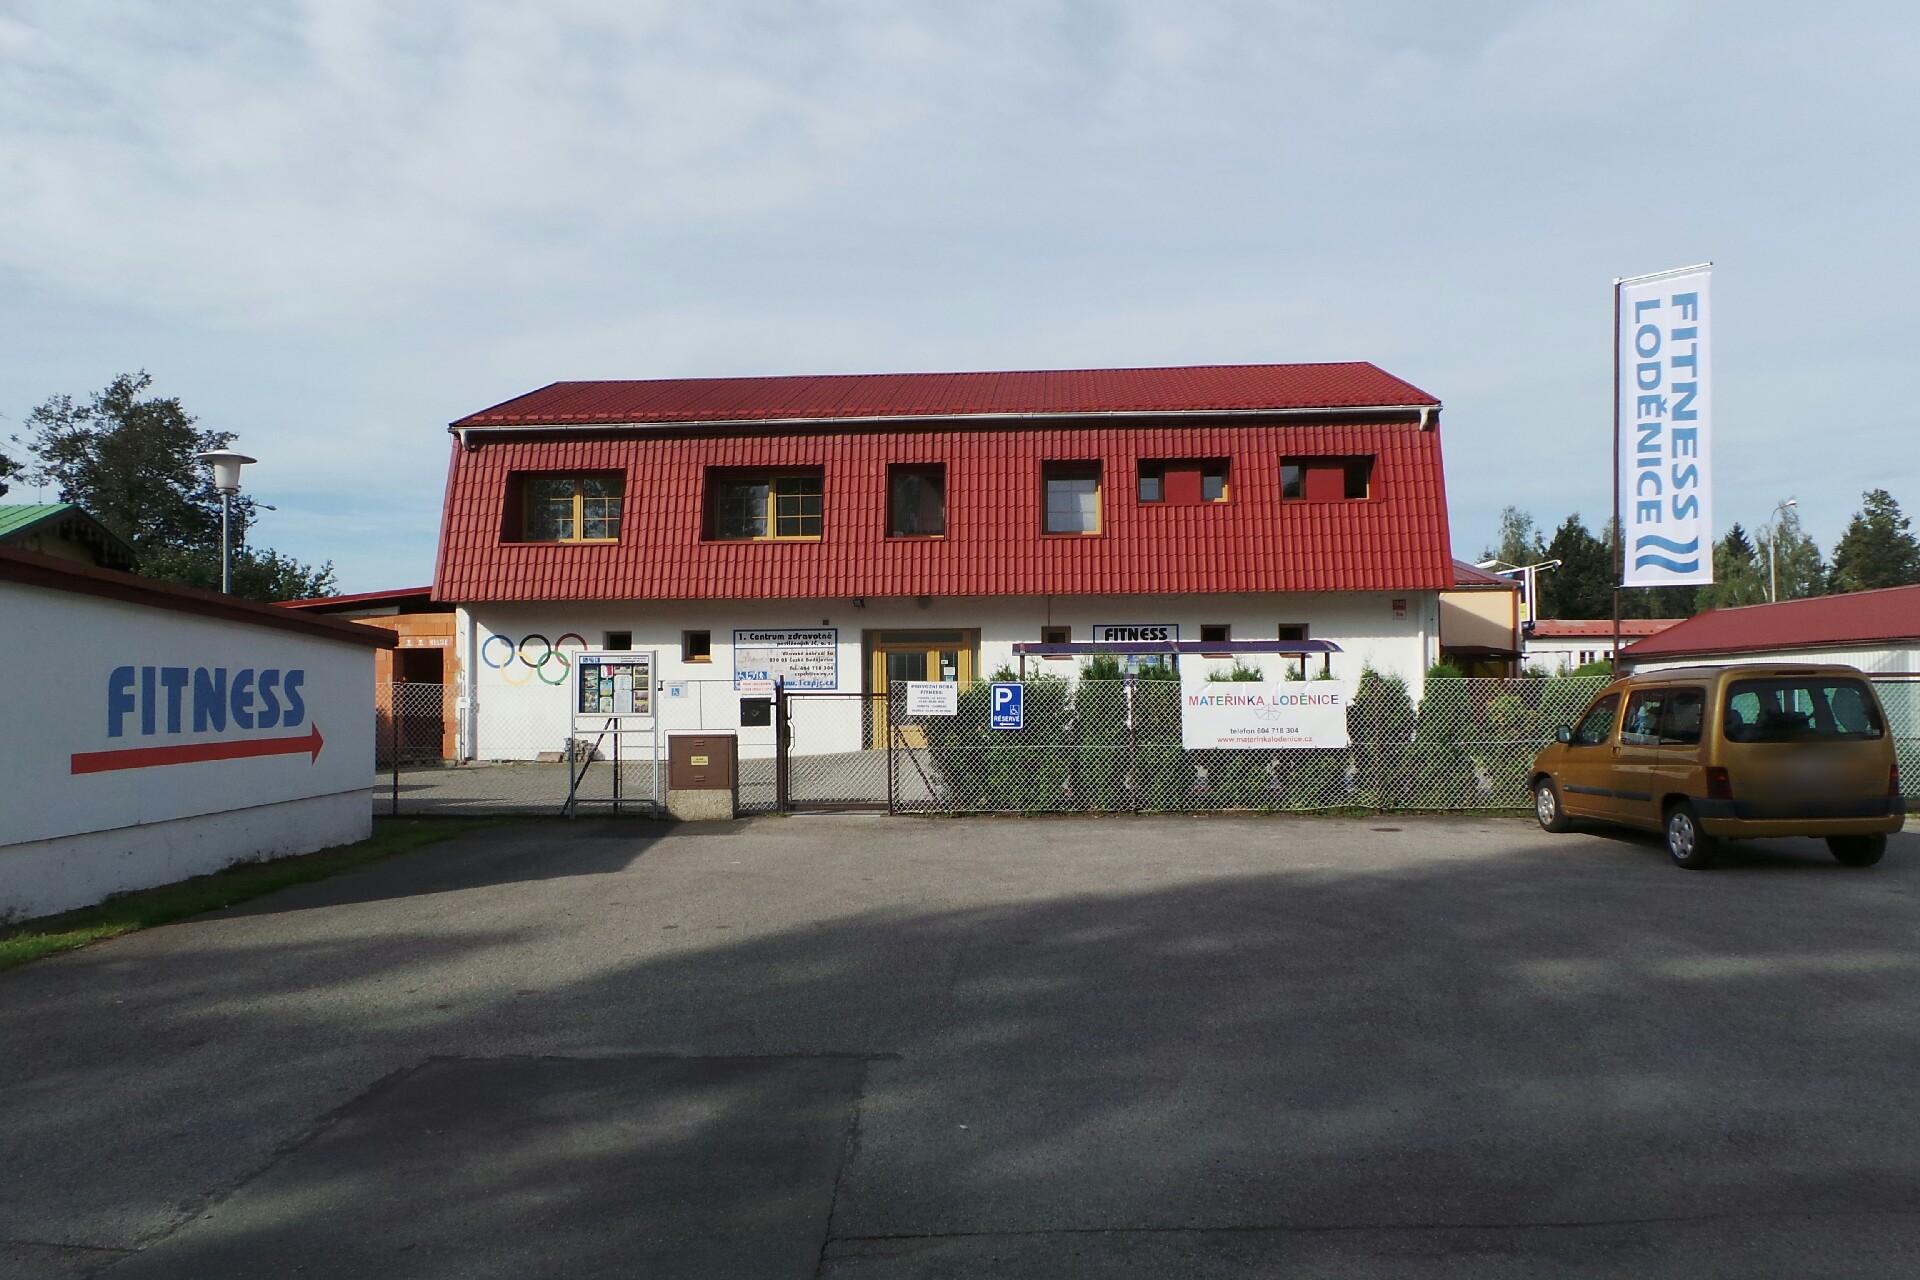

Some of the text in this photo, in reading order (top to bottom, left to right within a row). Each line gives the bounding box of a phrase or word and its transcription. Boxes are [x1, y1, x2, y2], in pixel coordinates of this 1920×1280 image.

[1634, 298, 1667, 524] LODĚNICE
[1671, 292, 1698, 521] FITNESS
[738, 633, 746, 641] 1.
[750, 633, 784, 641] Centrum
[1104, 628, 1168, 642] FITNESS
[108, 666, 305, 738] FITNESS
[996, 688, 1012, 712] P
[1188, 692, 1340, 706] MATEŘINKA LODĚNICE
[1217, 735, 1313, 744] www.materinkalodenice.cz
